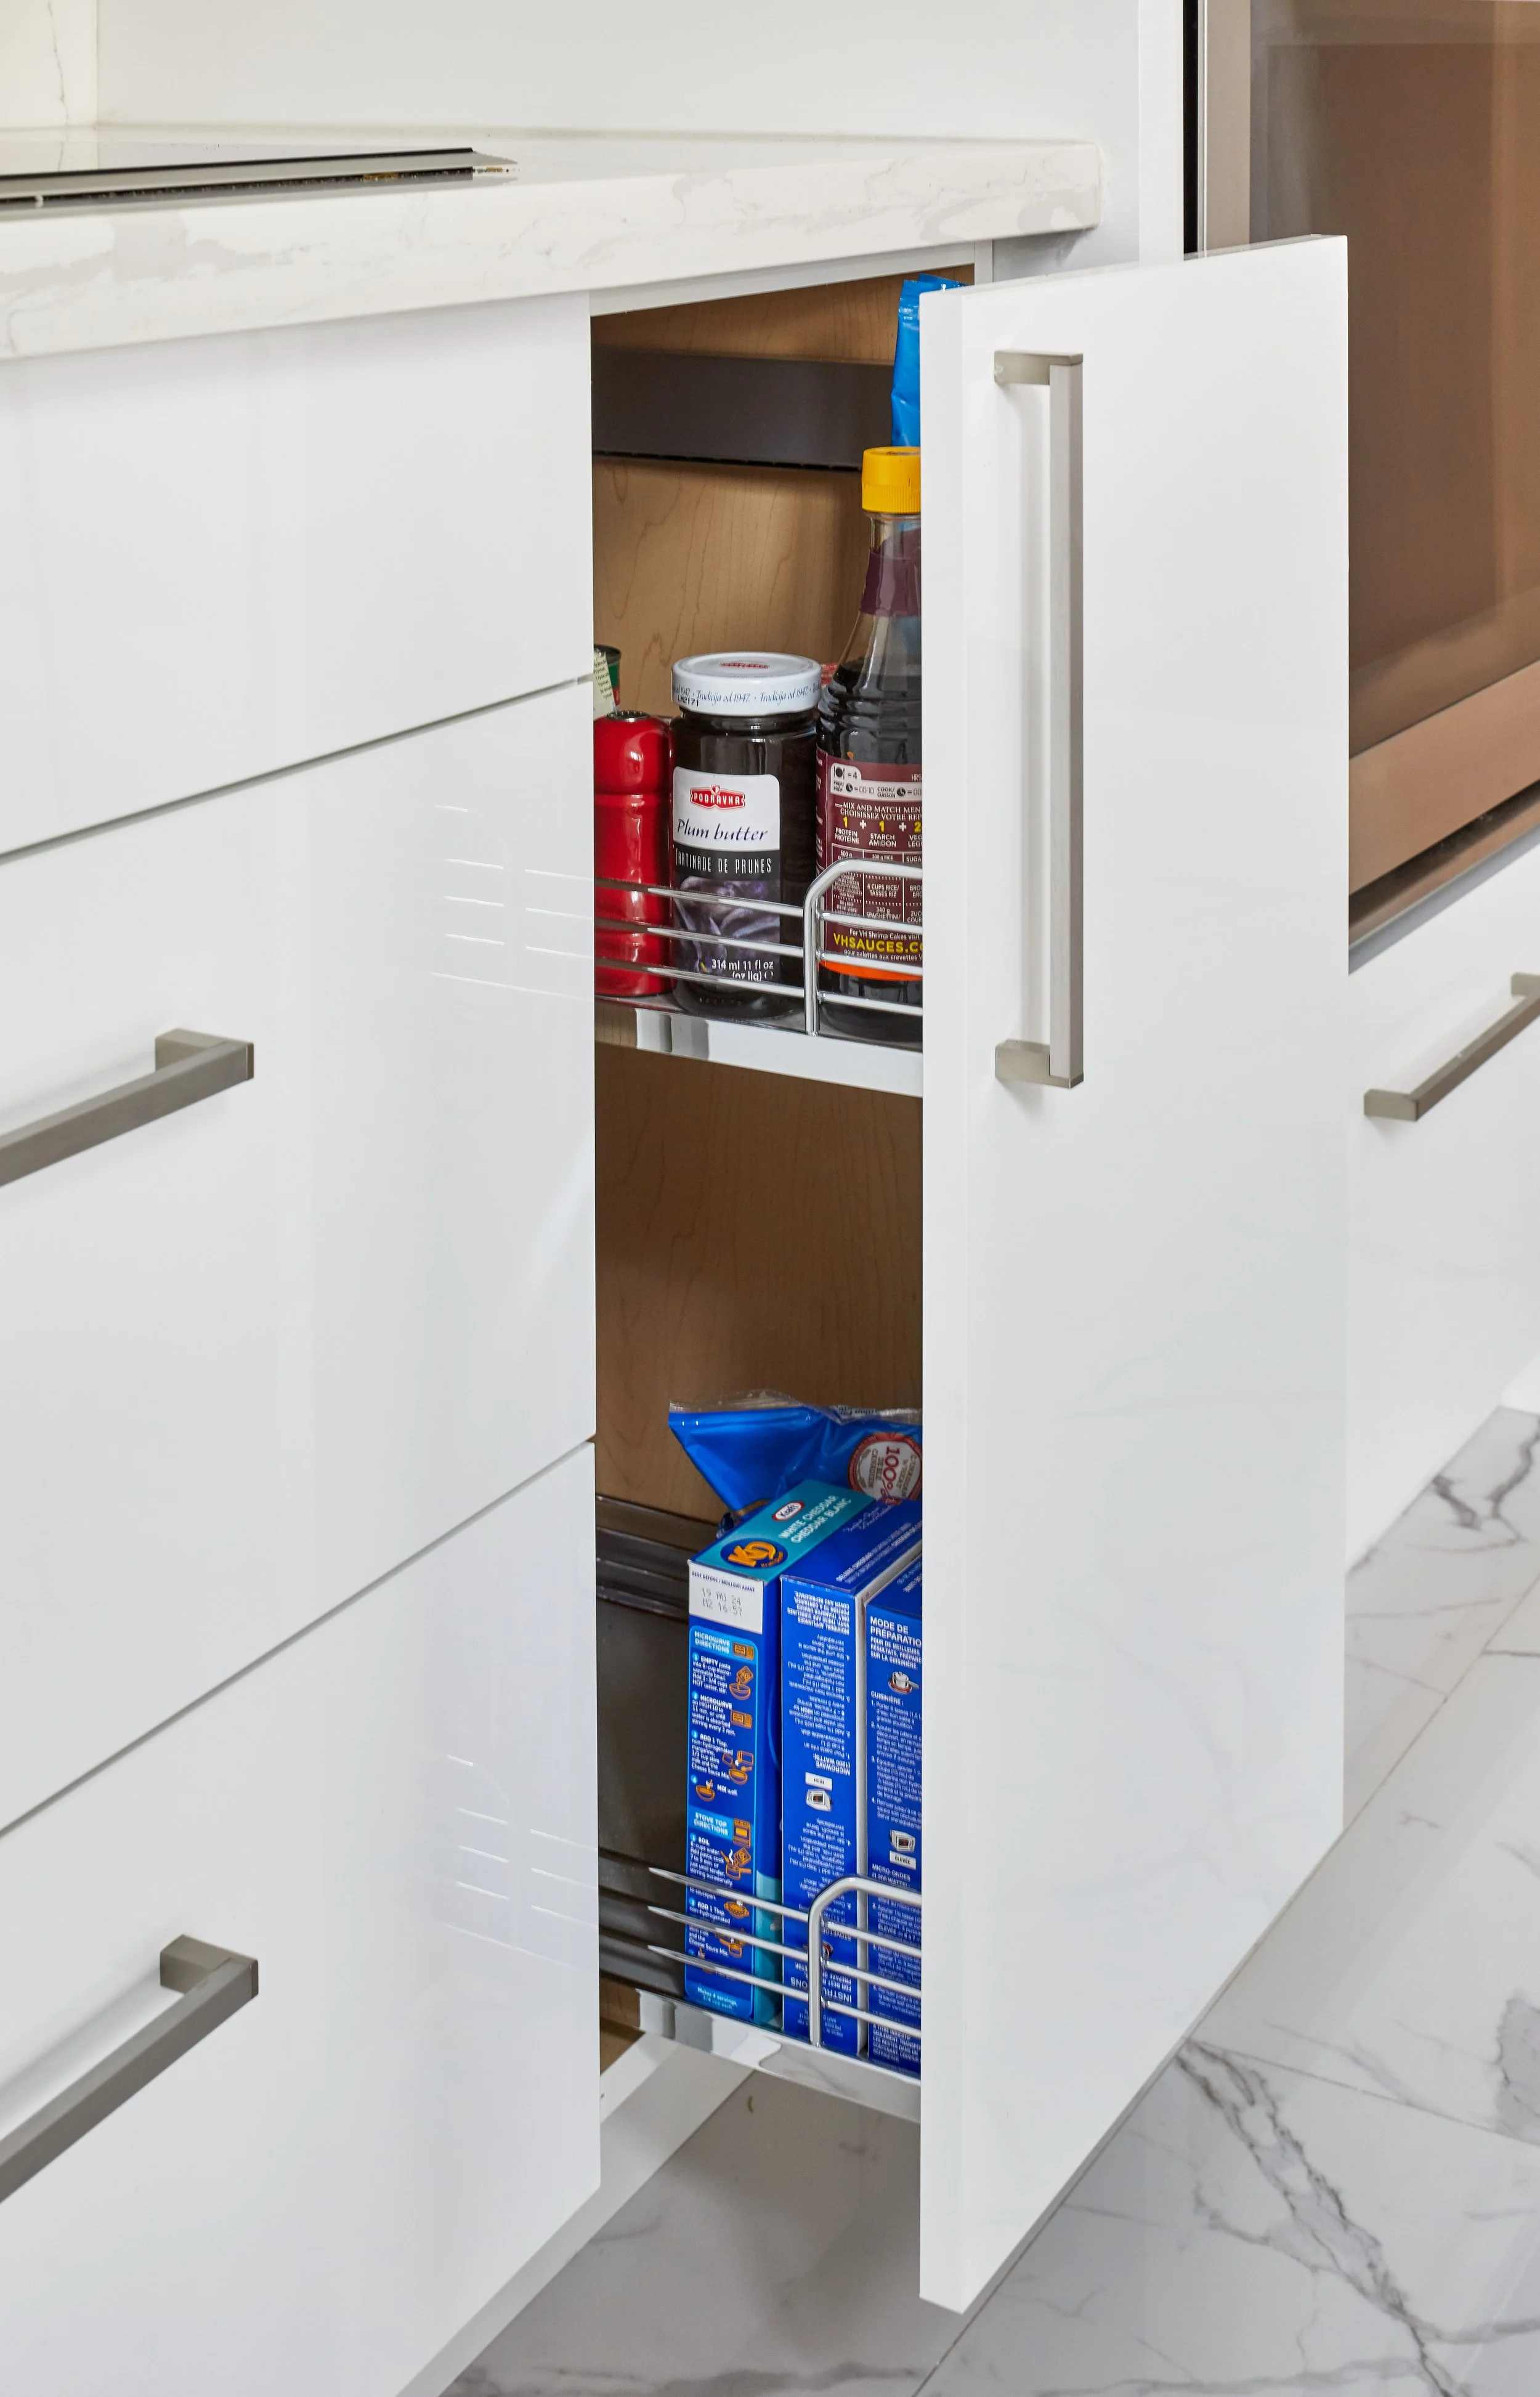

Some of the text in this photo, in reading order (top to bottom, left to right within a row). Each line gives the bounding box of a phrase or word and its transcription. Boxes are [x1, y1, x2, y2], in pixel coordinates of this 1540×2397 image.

[840, 808, 879, 820] CHOISISSEZ
[857, 803, 872, 812] AND
[874, 805, 901, 813] MATCH
[677, 818, 768, 841] Plum butter
[843, 816, 922, 833] 1 1 2
[835, 827, 858, 838] PROTEIN
[870, 833, 895, 841] STARCH
[869, 840, 896, 848] AMIDON
[676, 848, 771, 874] TARTINADE DE PRUNES
[870, 890, 886, 898] TASSES
[866, 912, 901, 920] SPAGHETTINI/
[849, 928, 858, 936] For
[869, 931, 888, 940] Shrimp
[711, 959, 774, 971] 314 ml 11 fl oz
[780, 1502, 800, 1518] Kraft
[779, 1520, 806, 1538] WHITE
[803, 1495, 838, 1520] CHEDDAR
[791, 1516, 829, 1543] CHEDDAR
[703, 1574, 718, 1583] BEFORE
[721, 1580, 741, 1589] MEILLEUR
[742, 1584, 755, 1592] AVANT
[716, 1591, 726, 1602] AU
[830, 1606, 849, 1616] PORTION
[835, 1601, 849, 1609] COVER
[787, 1607, 811, 1619] GUIDELINES
[814, 1608, 836, 1618] TRANSFER
[797, 1616, 849, 1635] INDIVIDUAL APPLIANCES
[870, 1616, 908, 1634] MODE DE
[694, 1631, 729, 1646] MICROWAVE
[695, 1638, 729, 1654] DIRECTIONS
[870, 1636, 883, 1645] POUR
[893, 1642, 920, 1656] MEILLEURS
[870, 1651, 880, 1659] SUR
[700, 1656, 730, 1670] EMPTY pasta
[692, 1679, 703, 1687] HOT
[700, 1694, 732, 1710] MICROWAVE
[870, 1690, 901, 1705] CUISINIÈRE
[699, 1701, 711, 1710] HIGH
[700, 1733, 711, 1742] ADD
[816, 1761, 850, 1775] MICROWAVE
[836, 1759, 849, 1769] (1200
[717, 1783, 726, 1793] MIX
[695, 1812, 726, 1828] STOVE TOP
[694, 1818, 728, 1836] DIRECTIONS
[699, 1836, 710, 1846] BOIL
[691, 1847, 724, 1863] Add cook
[872, 1864, 910, 1882] MICRO-ONDES
[697, 1901, 708, 1911] ADD
